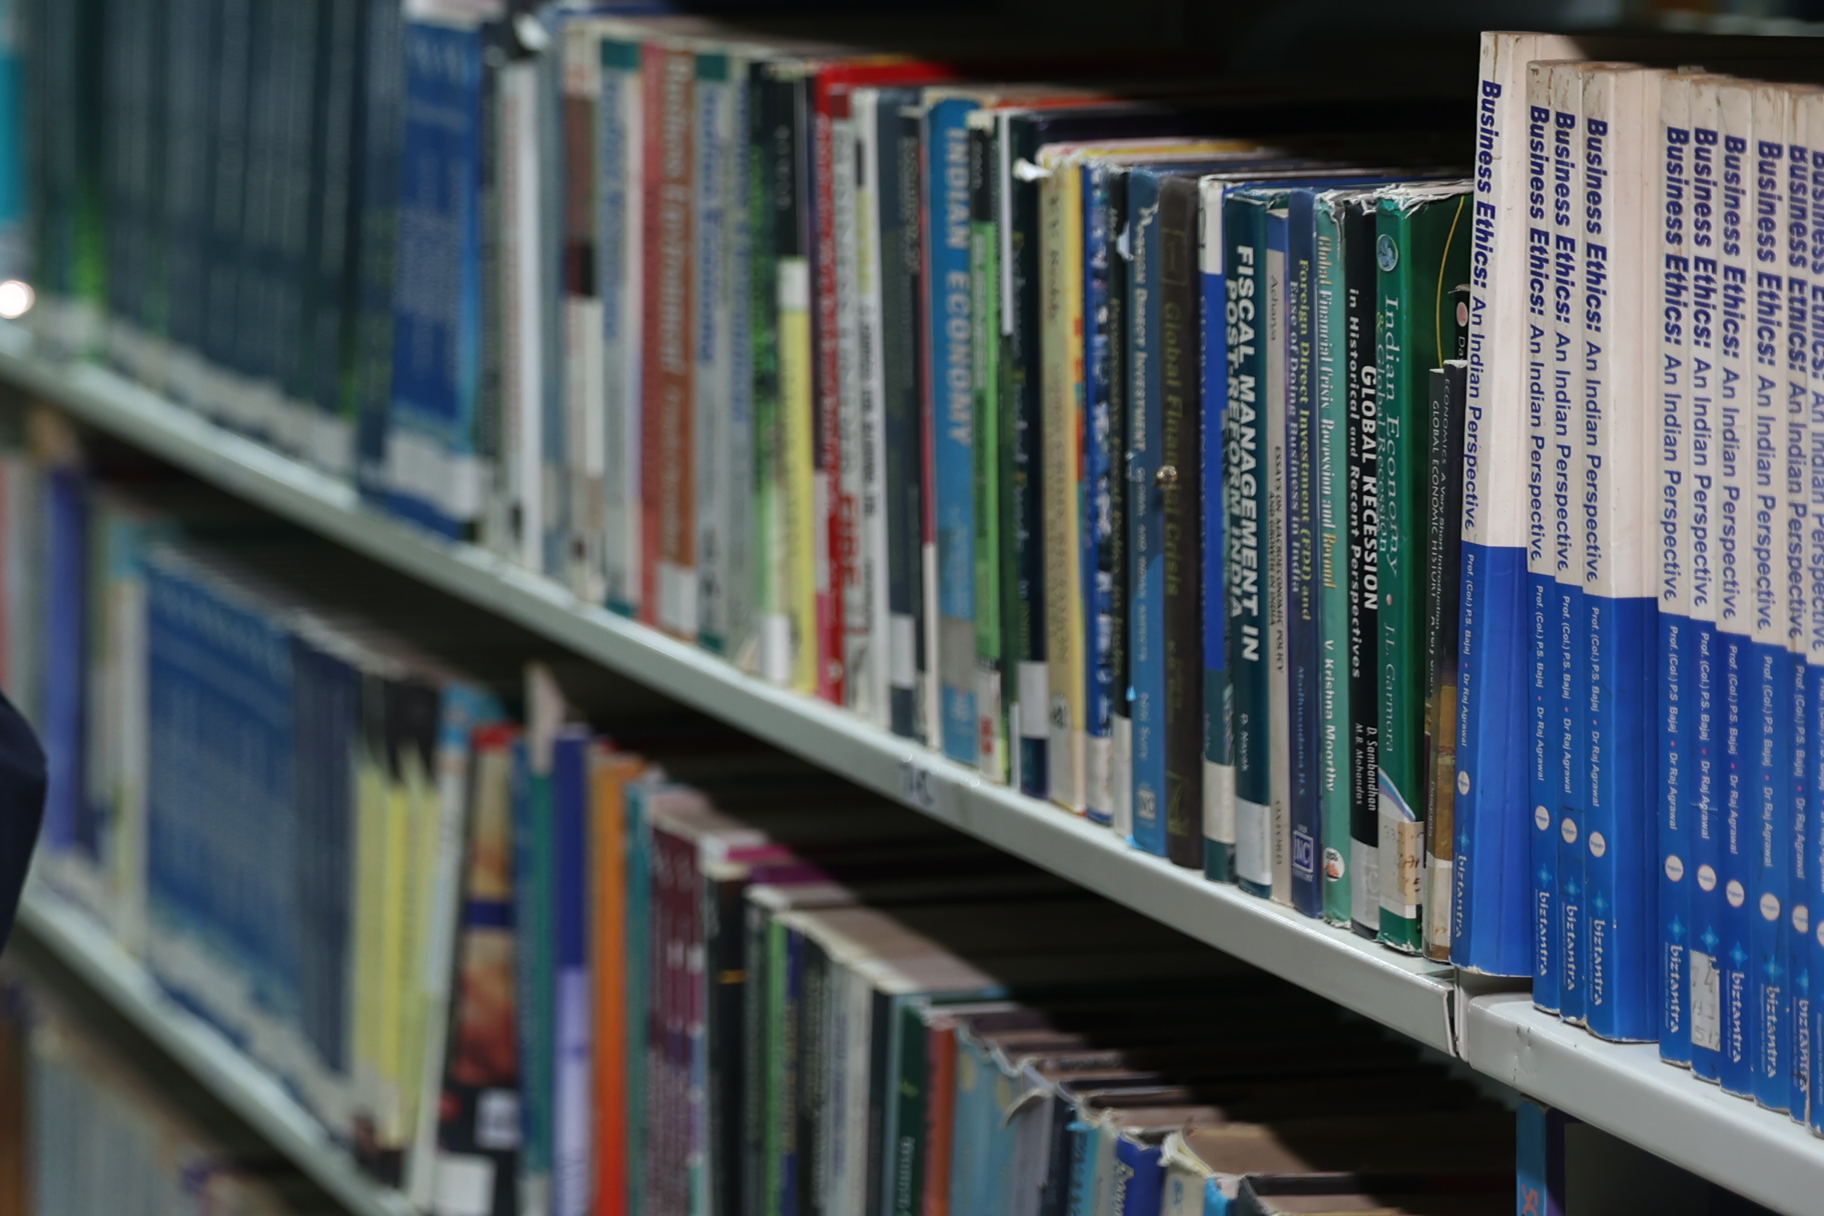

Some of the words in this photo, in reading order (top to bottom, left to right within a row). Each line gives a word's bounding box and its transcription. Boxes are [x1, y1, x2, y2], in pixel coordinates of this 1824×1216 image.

[1475, 78, 1502, 195] Business
[1529, 104, 1551, 221] Business
[1585, 117, 1609, 235] Business
[944, 126, 969, 251] INDIAN
[1693, 126, 1719, 249] Business
[1756, 139, 1784, 264] Business
[1472, 199, 1497, 290] Ethics:
[1528, 225, 1551, 317] Ethics:
[1584, 240, 1608, 333] Ethics:
[1236, 245, 1256, 364] FISCAL
[1296, 259, 1309, 337] Foreign
[1349, 288, 1359, 309] in
[1470, 294, 1487, 327] An
[1529, 323, 1546, 355] An
[1693, 254, 1718, 349] Ethics:
[1756, 270, 1783, 367] Ethics:
[1297, 341, 1311, 406] Direct
[1349, 316, 1360, 421] Historical
[1384, 296, 1401, 402] Indian
[1468, 332, 1486, 399] Indian
[1585, 339, 1603, 372] An
[1693, 355, 1713, 389] An
[1756, 374, 1777, 407] An
[1224, 278, 1242, 521] POST-REFORM
[1360, 364, 1378, 465] GLOBAL
[1431, 400, 1441, 455] GLOBAL
[1529, 361, 1546, 429] Indian
[1585, 378, 1603, 447] Indian
[1693, 395, 1713, 467] Indian
[1298, 409, 1312, 529] Investment
[1349, 425, 1358, 459] and
[1463, 405, 1483, 531] Perspective
[1756, 414, 1777, 488] Indian
[1236, 375, 1260, 618] MANAGEMENT
[1350, 465, 1361, 538] Recent
[1385, 415, 1402, 580] Economy
[1430, 458, 1440, 533] ECONOMIC
[1527, 433, 1546, 562] Perspective
[1583, 453, 1602, 583] Perspective
[1228, 525, 1243, 618] INDIA
[1361, 474, 1379, 610] RECESSION
[1690, 473, 1713, 608] Perspective
[1752, 493, 1777, 631] Perspective
[1242, 624, 1260, 662] IN
[1301, 584, 1312, 622] and
[1349, 544, 1362, 679] Perspectives
[1591, 607, 1600, 632] Prof.
[1590, 634, 1600, 663] (Col.)
[1591, 664, 1601, 683] P.S.
[1590, 686, 1600, 712] Bajaj
[1591, 731, 1601, 744] Dr
[1590, 764, 1600, 807] Agrawal
[1591, 745, 1600, 763] Raj
[1454, 854, 1468, 938] biztantra
[1537, 890, 1551, 977] biztantra
[1592, 918, 1607, 1007] biztantra
[1766, 985, 1782, 1078] biztantra
